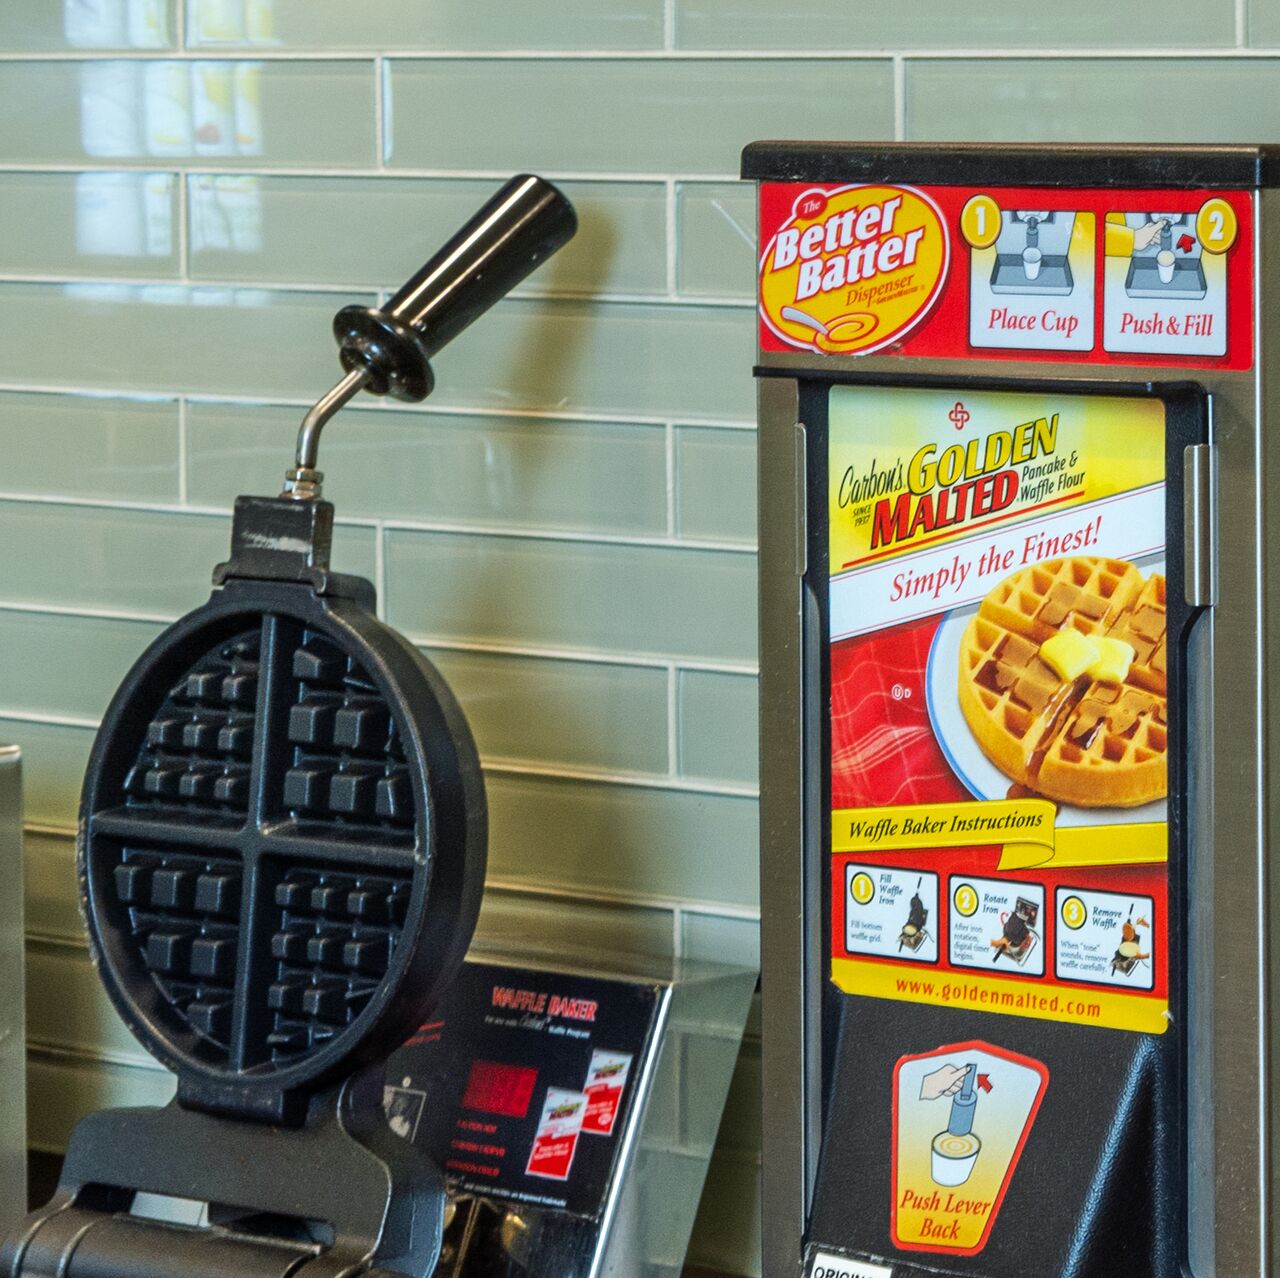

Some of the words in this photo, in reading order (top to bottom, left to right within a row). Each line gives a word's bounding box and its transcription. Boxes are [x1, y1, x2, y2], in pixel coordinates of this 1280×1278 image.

[802, 200, 821, 214] The
[974, 206, 986, 236] 1
[772, 195, 902, 271] Better
[1208, 210, 1225, 240] 2
[796, 228, 925, 301] Batter
[846, 274, 914, 307] Dispenser
[988, 308, 1038, 330] Place
[1042, 310, 1080, 337] Cup
[1120, 312, 1164, 334] Push
[1167, 318, 1180, 336] &
[1183, 312, 1214, 336] Fill
[838, 457, 903, 508] Carbon's
[907, 414, 1060, 496] GOLDEN
[1022, 456, 1066, 482] Pancake
[1069, 450, 1078, 468] &
[1020, 478, 1054, 503] Waffle
[1057, 472, 1086, 491] Flour
[852, 504, 872, 516] SINCE
[870, 470, 1019, 550] MALTED
[890, 554, 973, 606] Simply
[976, 543, 1022, 578] the
[1023, 515, 1103, 566] Finest!
[850, 818, 899, 842] Waffle
[901, 815, 946, 836] Baker
[949, 812, 1044, 832] Instructions
[860, 880, 866, 896] 1
[880, 874, 892, 884] Fill
[880, 884, 902, 896] Waffle
[878, 896, 894, 905] Iron
[962, 892, 971, 908] 2
[984, 894, 1008, 904] Rotate
[982, 905, 998, 914] Iron
[1069, 904, 1078, 920] 3
[1092, 906, 1122, 918] Remove
[1092, 917, 1117, 930] Waffle
[492, 986, 548, 1014] WAFFLE
[547, 994, 599, 1022] BAKER
[896, 978, 1101, 1018] www.goldenmalted.com
[900, 1188, 939, 1212] Push
[944, 1194, 992, 1216] Lever
[919, 1220, 962, 1240] Back
